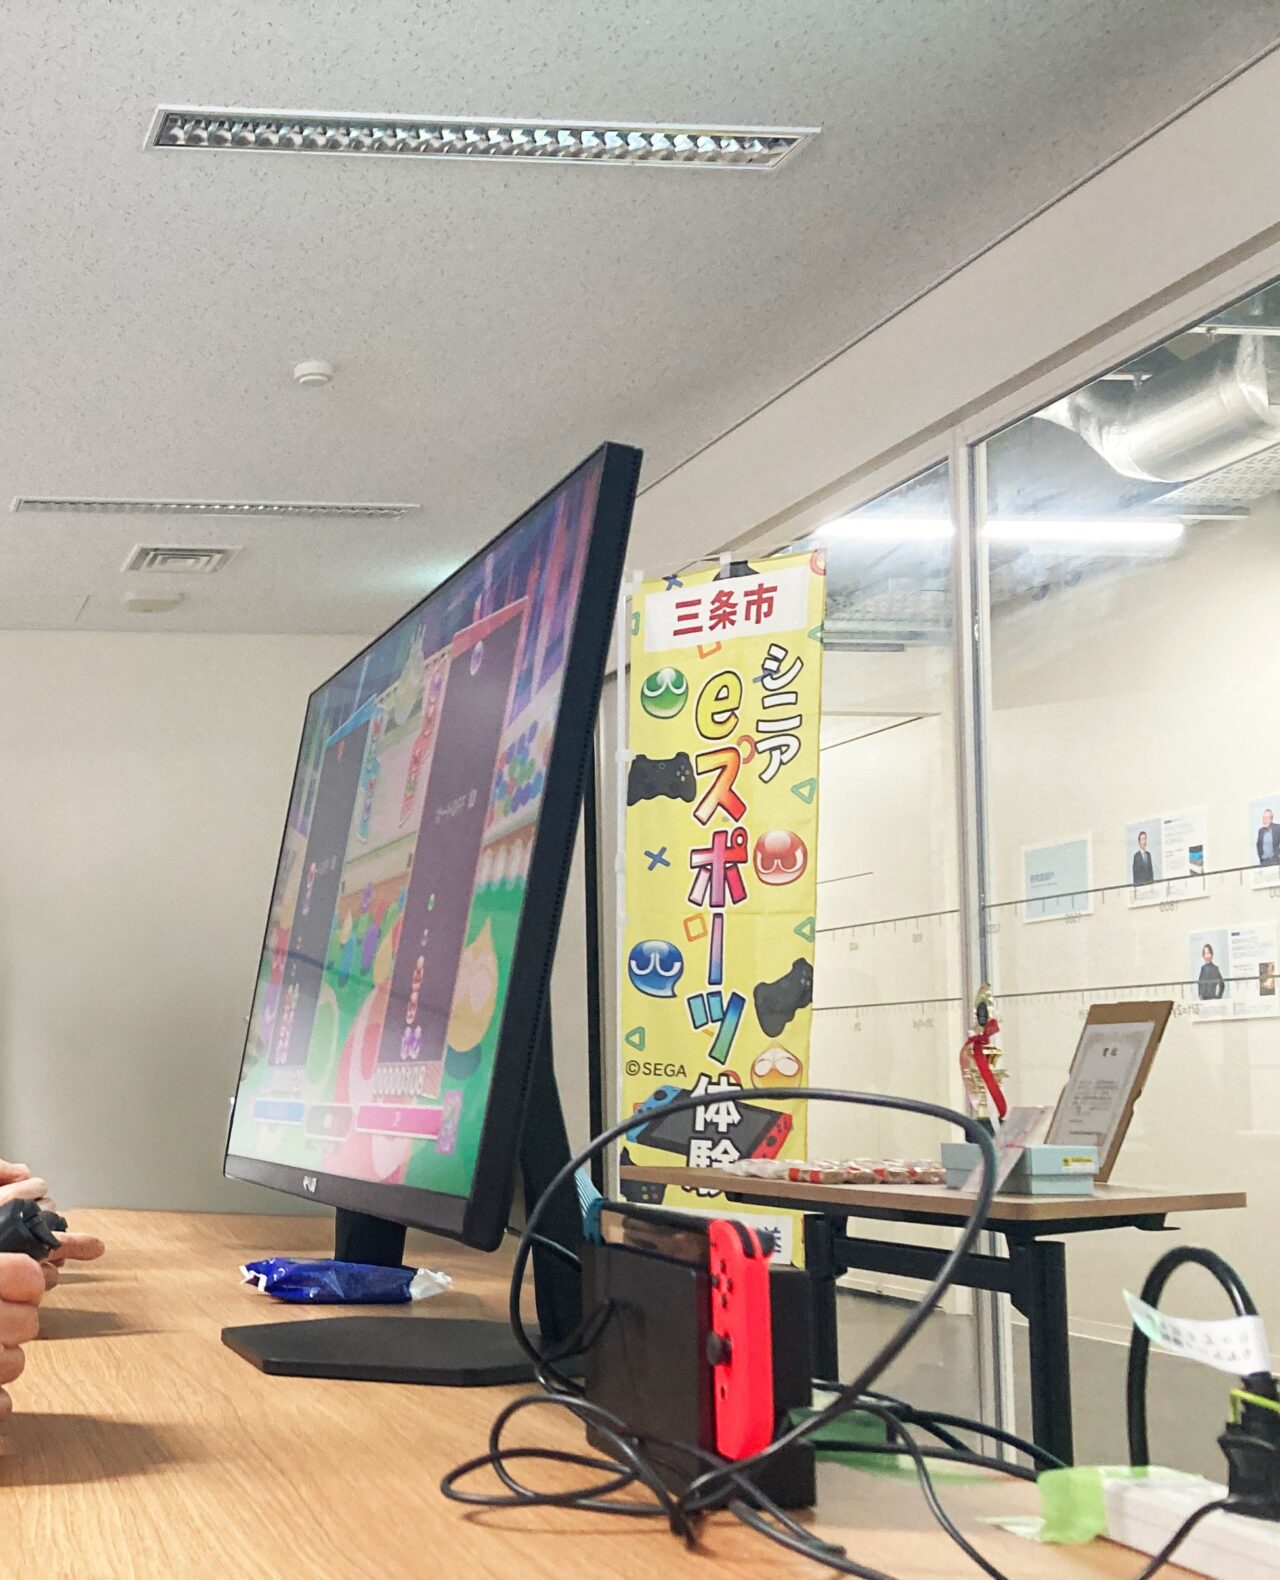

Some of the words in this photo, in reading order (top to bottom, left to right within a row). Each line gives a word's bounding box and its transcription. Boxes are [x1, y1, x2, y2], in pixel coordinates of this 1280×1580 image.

[672, 583, 778, 637] 三条市
[755, 643, 804, 784] シニア
